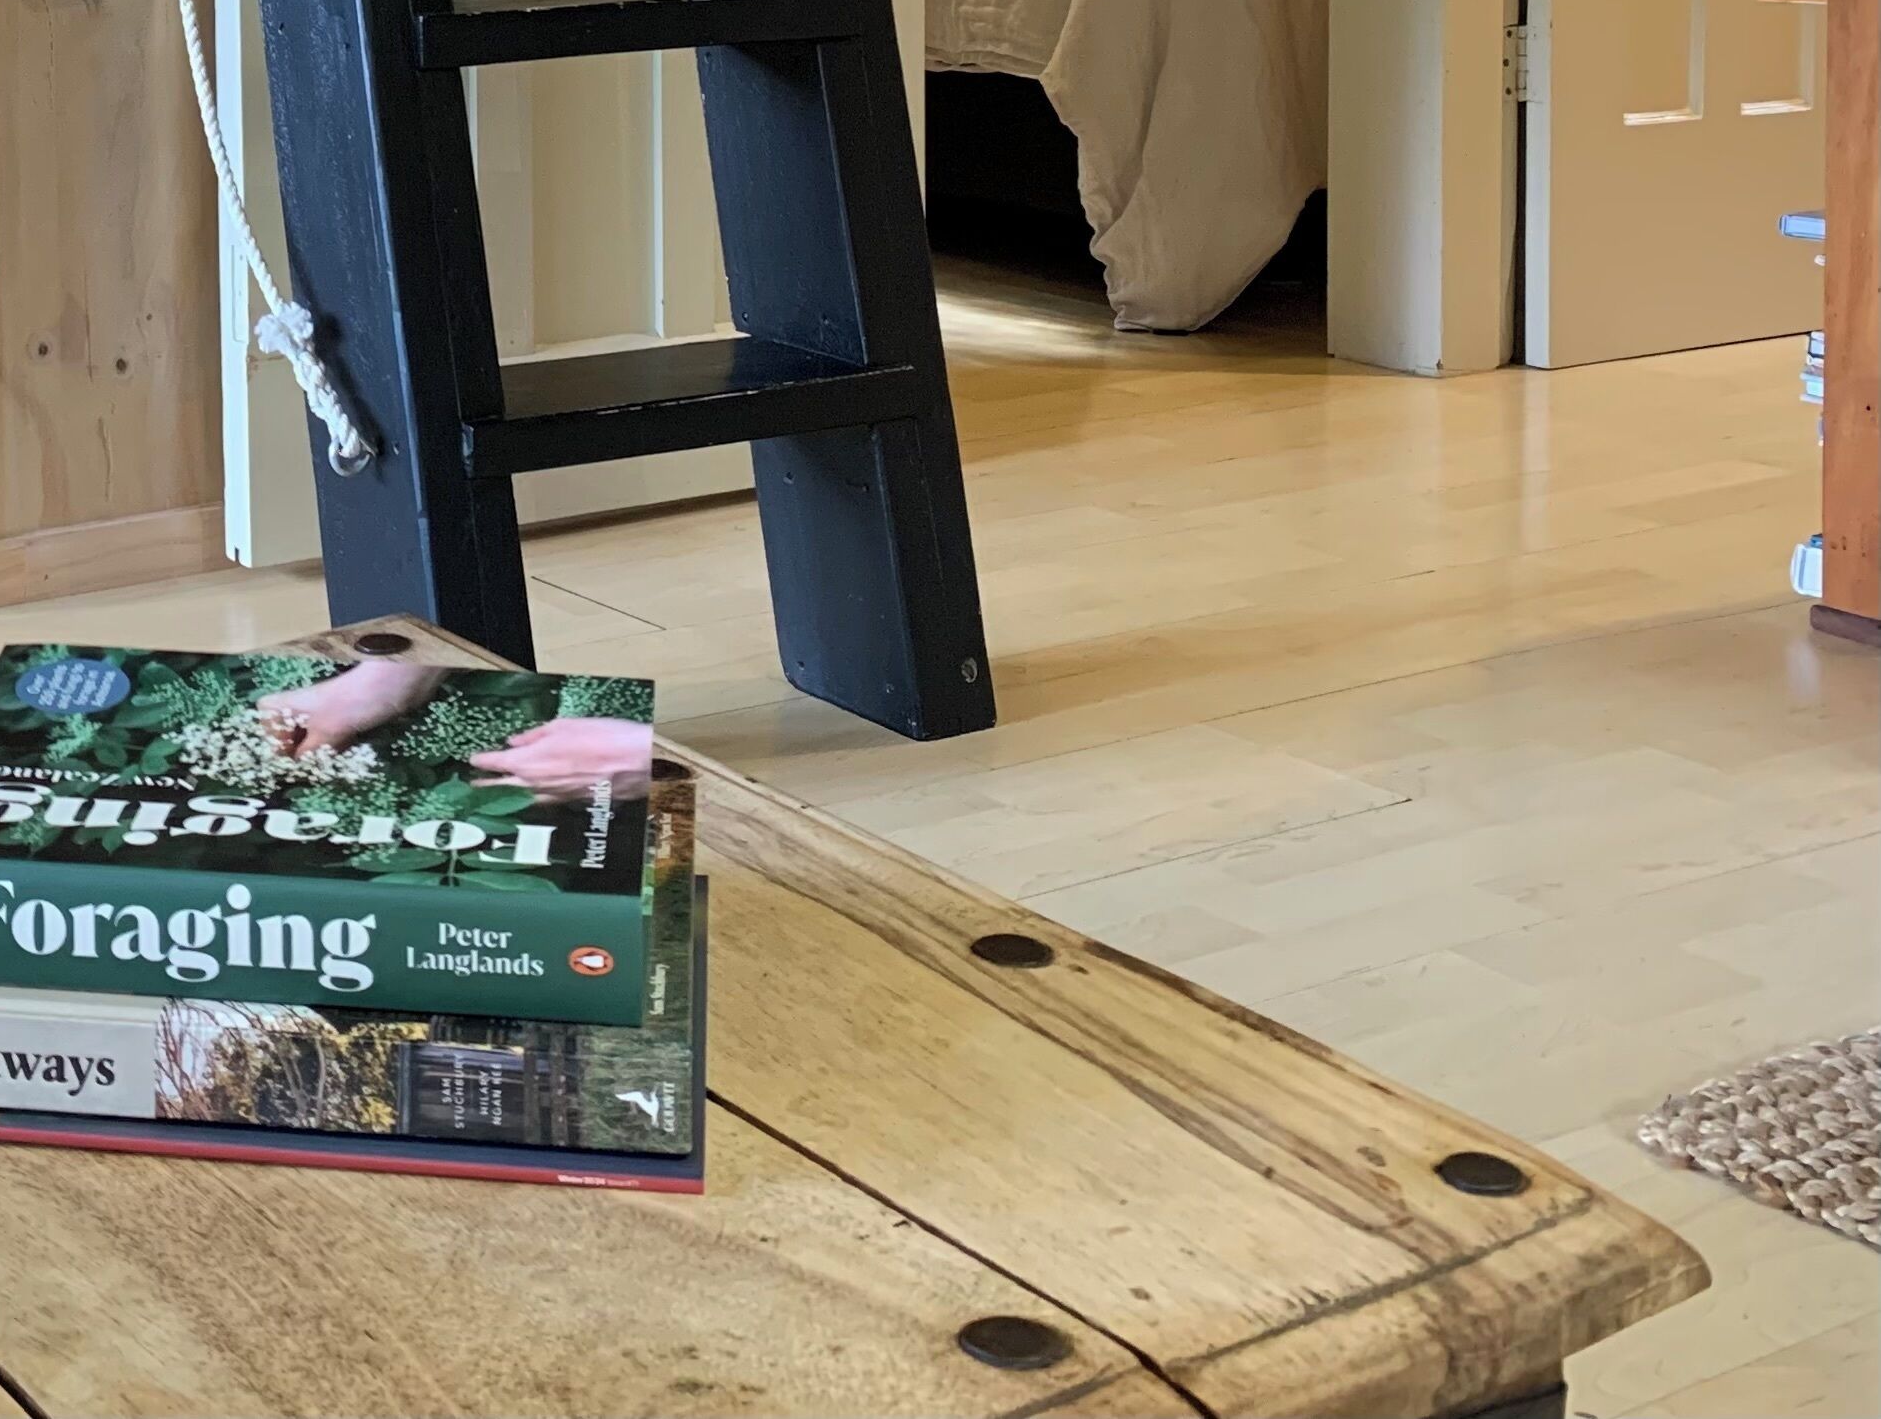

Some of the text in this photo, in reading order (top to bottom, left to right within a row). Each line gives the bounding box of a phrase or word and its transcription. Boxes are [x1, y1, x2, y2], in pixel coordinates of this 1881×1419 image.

[580, 780, 615, 869] Peter Langlands
[438, 921, 513, 950] Peter
[406, 945, 545, 978] Langlands
[442, 1077, 452, 1103] SAM
[479, 1070, 490, 1116] HILARY
[491, 1089, 503, 1126] NGAN
